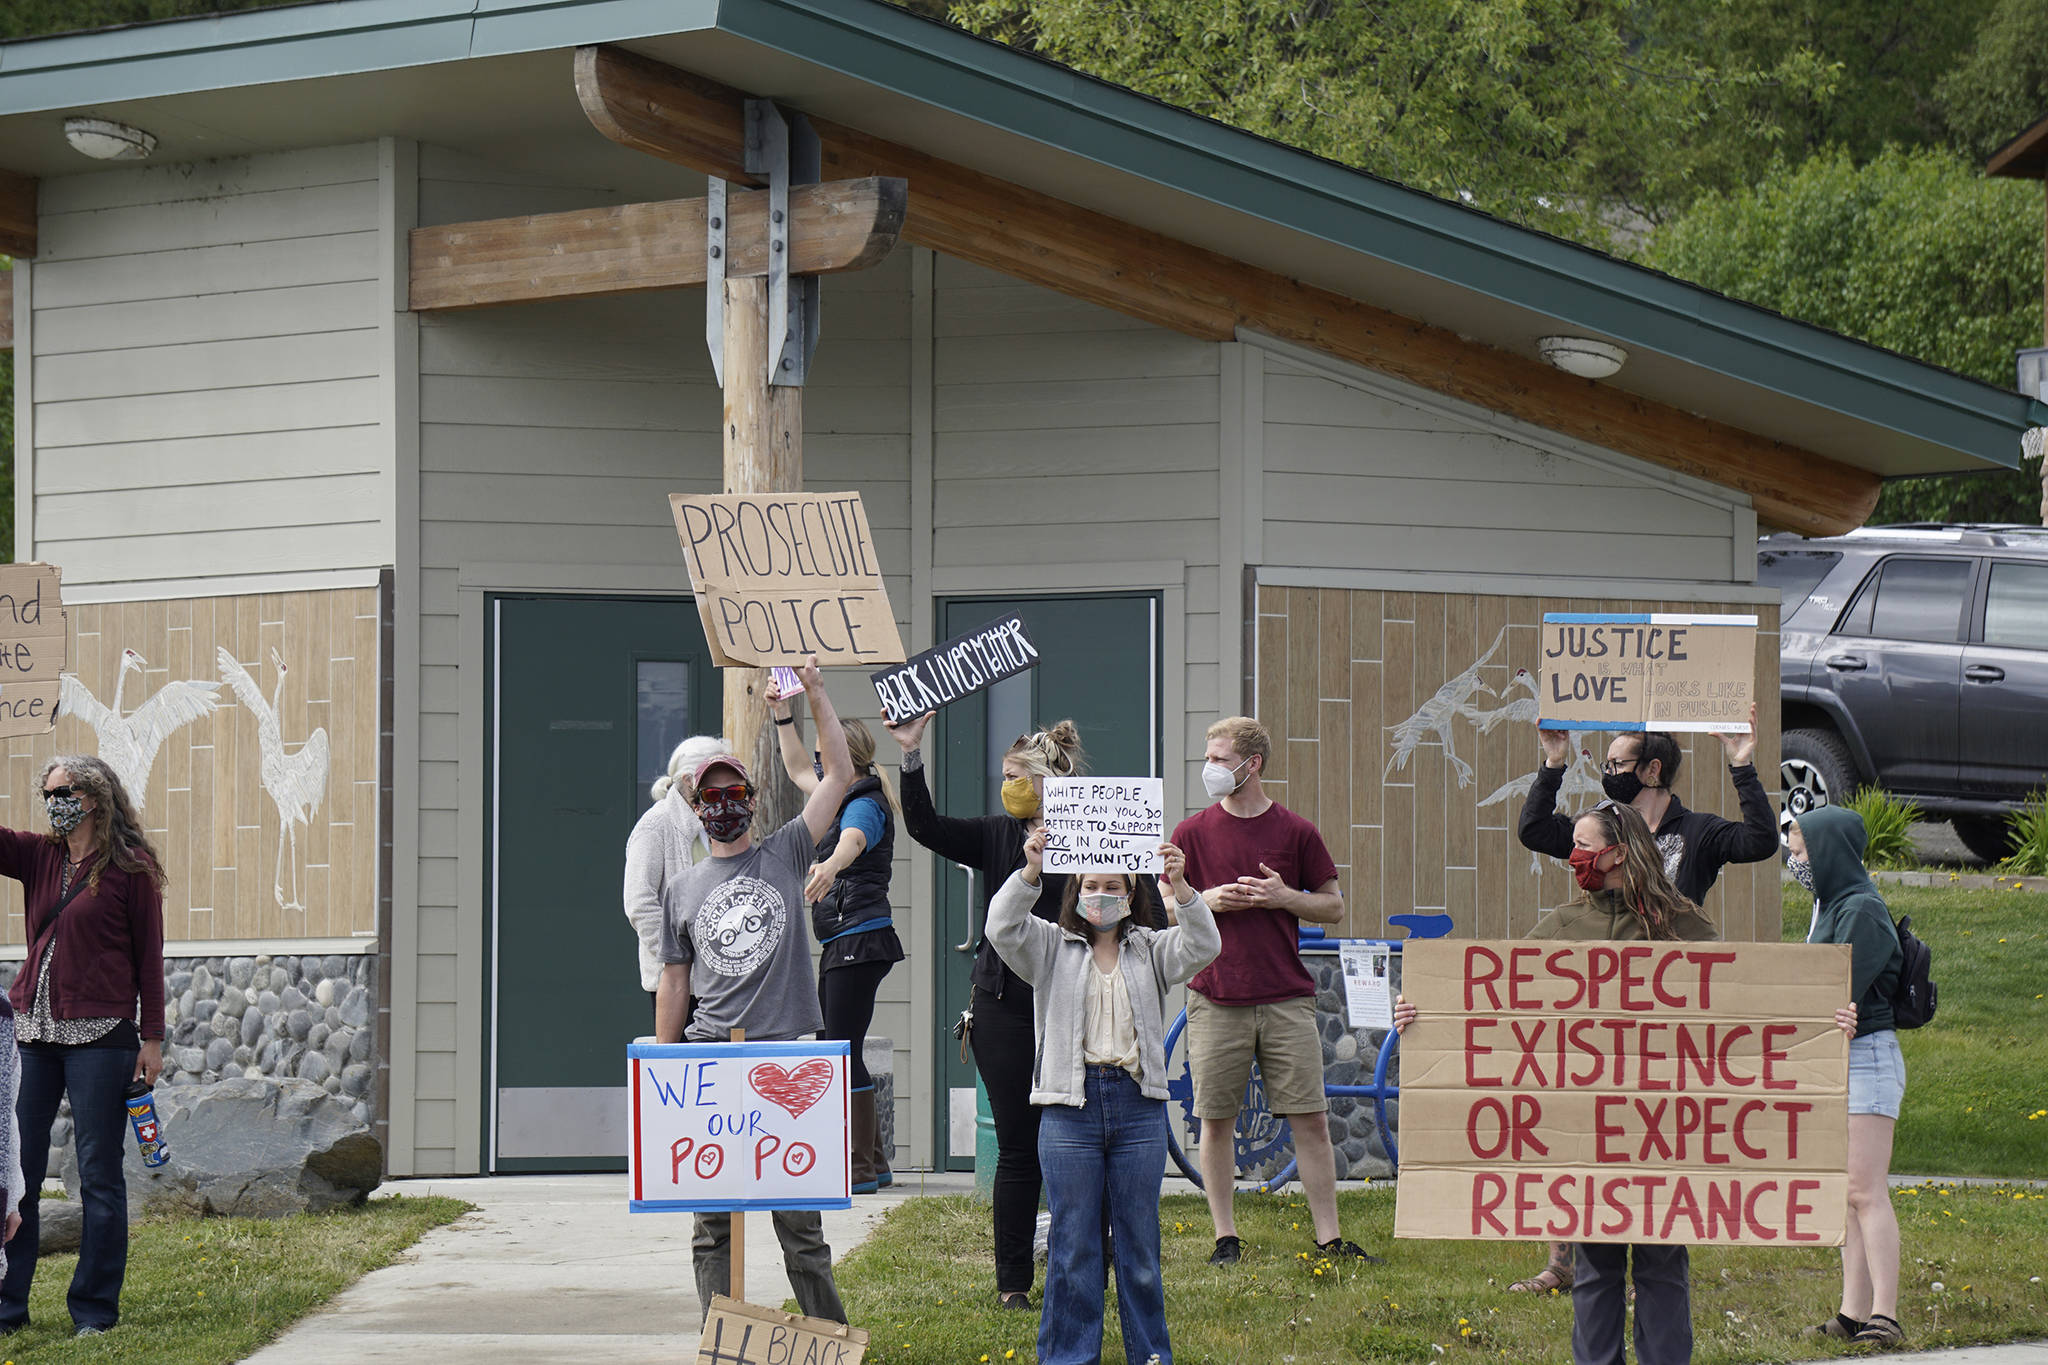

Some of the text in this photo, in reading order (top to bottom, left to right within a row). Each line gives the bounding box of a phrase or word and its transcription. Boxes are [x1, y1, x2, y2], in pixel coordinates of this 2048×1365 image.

[681, 497, 878, 579] PROSECUTE
[718, 596, 878, 655] POLICE
[1546, 627, 1688, 660] JUSTICE
[1597, 662, 1667, 676] IS WHAT
[1552, 672, 1628, 703] LOVE
[1645, 680, 1747, 698] LOOKS LIKE
[1654, 700, 1741, 718] IN PUBLIC
[1045, 786, 1085, 800] WHITE
[1045, 804, 1079, 815] WHAT
[1083, 805, 1108, 816] CAN
[1145, 808, 1162, 819] DO
[1045, 819, 1162, 833] BETTER TO SUPPORT
[1045, 834, 1071, 848] POC
[1076, 836, 1090, 847] IN
[706, 901, 730, 941] CYCLE
[1464, 945, 1737, 1011] RESPECT
[1464, 1017, 1798, 1091] EXISTENCE
[647, 1061, 719, 1109] WE
[707, 1110, 772, 1137] OUR
[1466, 1094, 1813, 1164] OR EXPECT
[670, 1135, 817, 1184] PO PO
[1471, 1173, 1821, 1241] RESISTANCE
